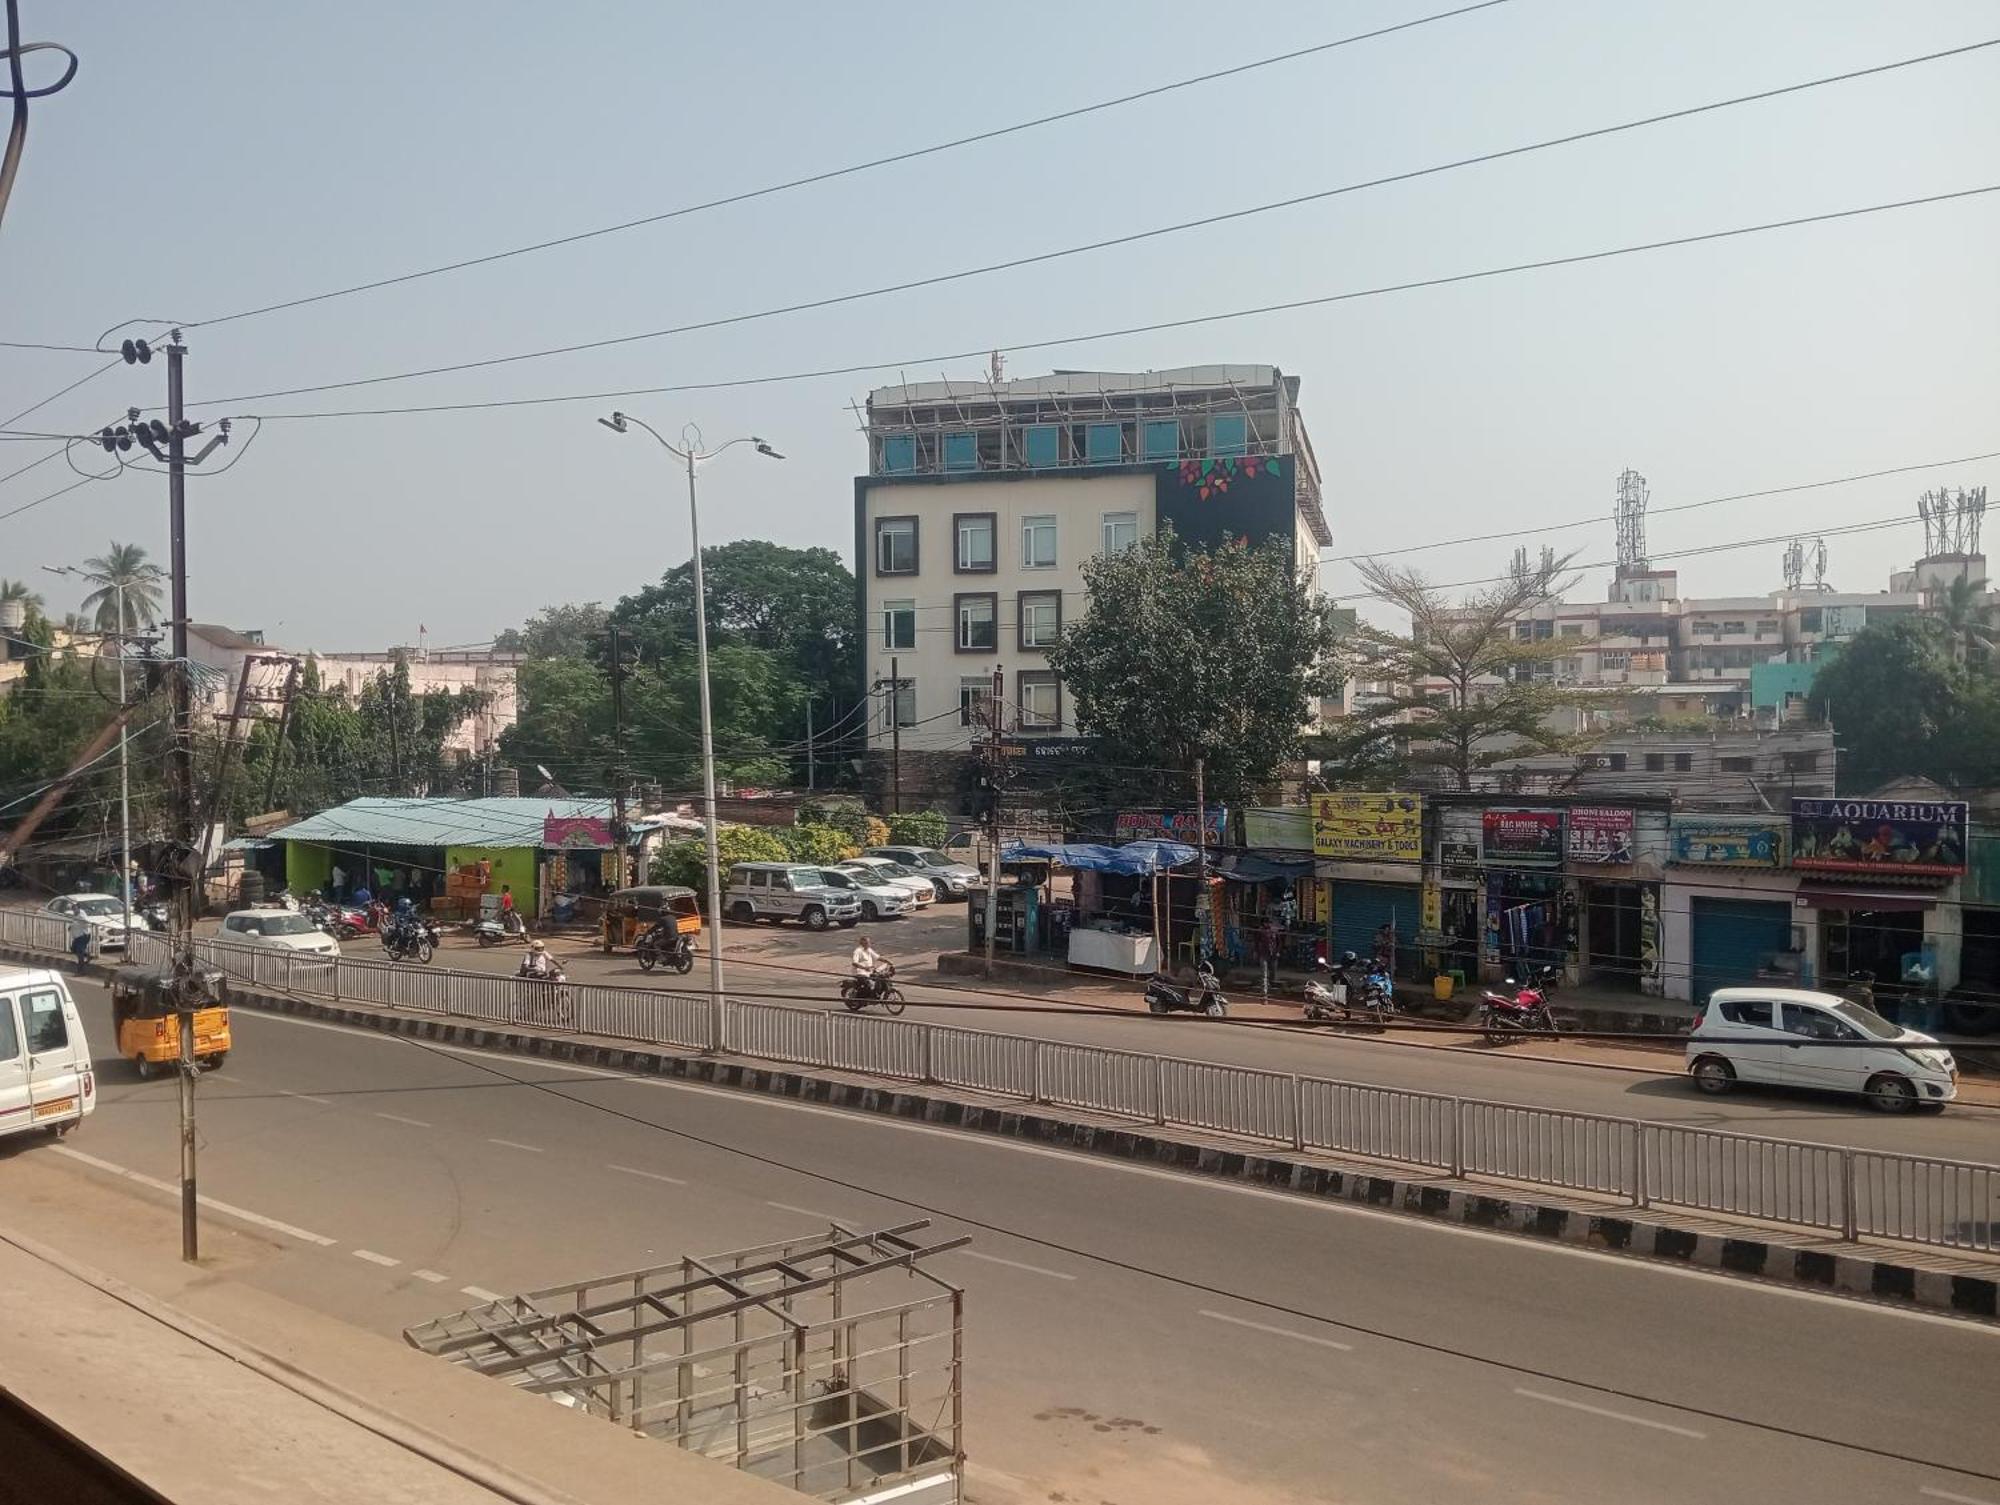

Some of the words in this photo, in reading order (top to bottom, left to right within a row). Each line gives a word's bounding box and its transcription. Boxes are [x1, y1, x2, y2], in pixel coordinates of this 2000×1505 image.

[1830, 803, 1957, 822] AQUARIUM
[1316, 838, 1342, 848] GALAXY
[1344, 838, 1385, 850] MACHINERY
[1395, 841, 1418, 851] TOOLS
